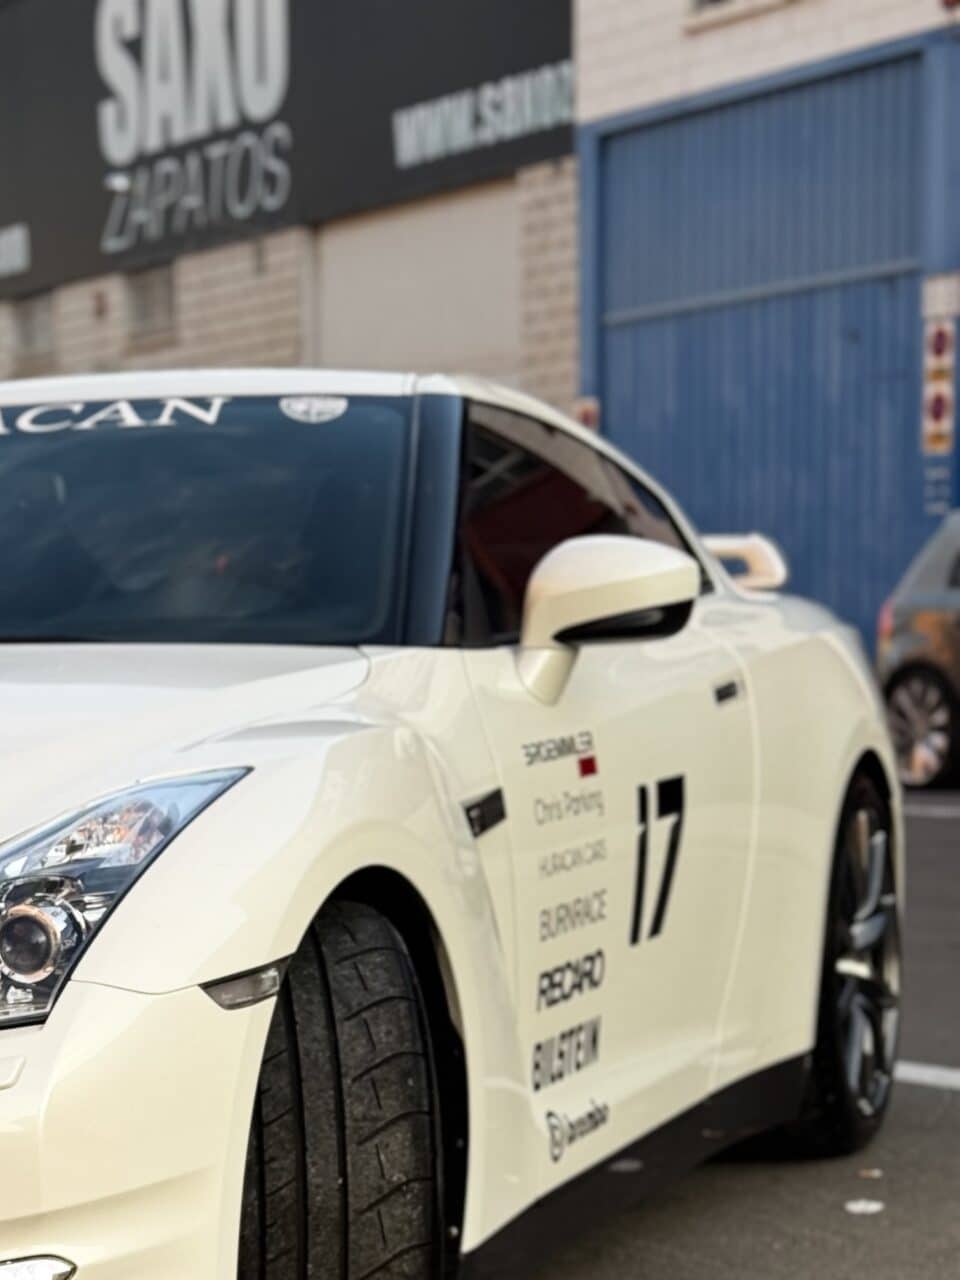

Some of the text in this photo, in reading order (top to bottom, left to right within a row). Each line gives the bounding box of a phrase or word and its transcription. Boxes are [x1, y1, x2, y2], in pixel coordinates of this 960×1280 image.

[94, 0, 291, 166] SAXO
[100, 121, 293, 254] ZAPATOS
[630, 774, 686, 947] 17
[537, 948, 605, 1013] RECARO
[533, 1013, 602, 1091] BILSTEIN
